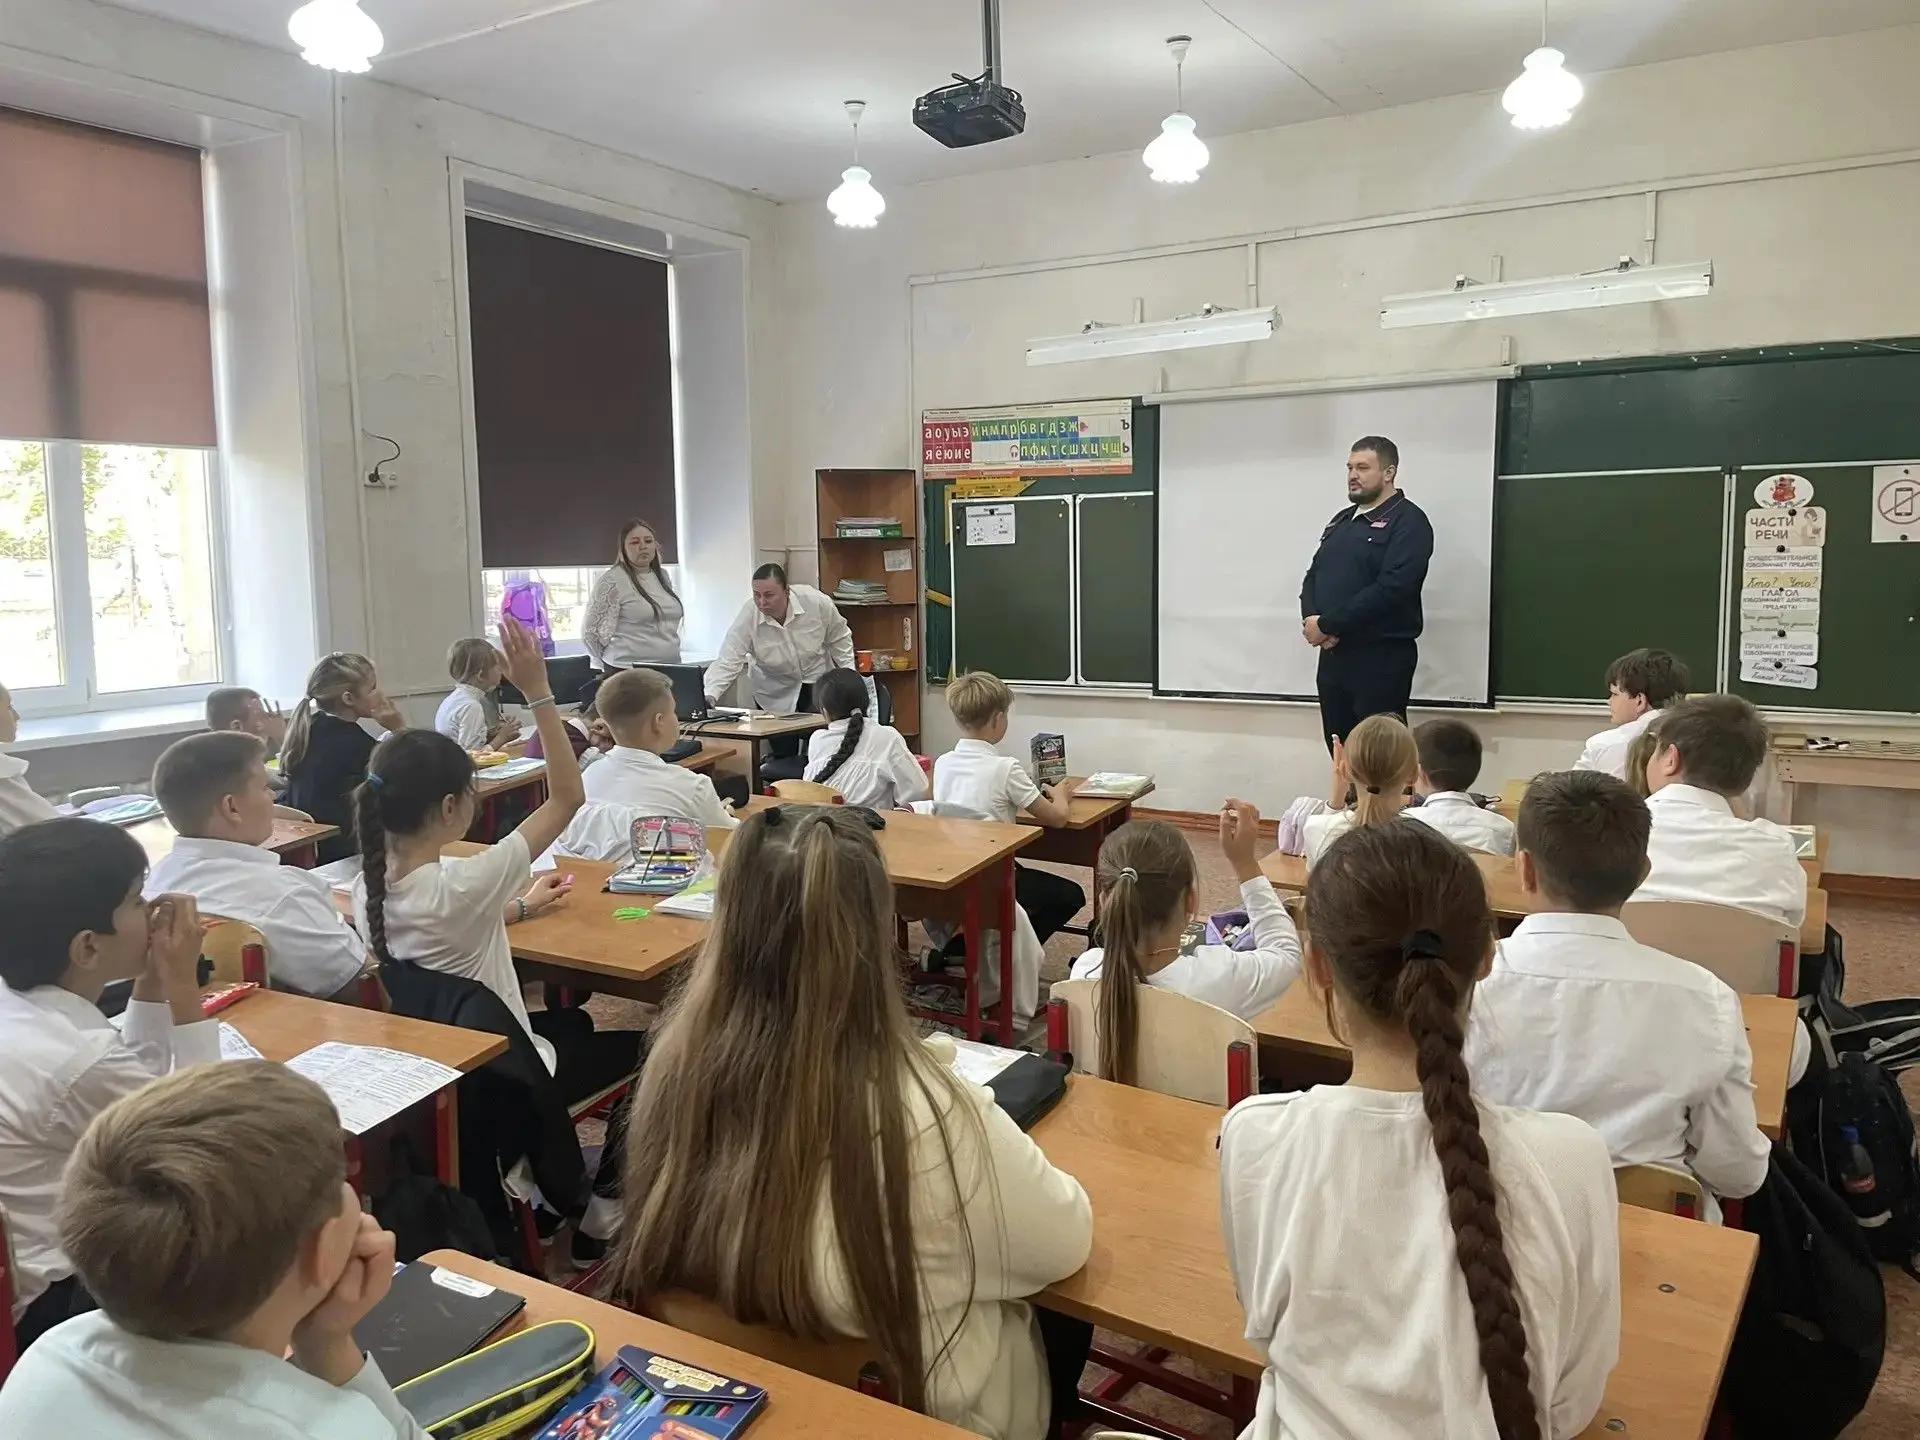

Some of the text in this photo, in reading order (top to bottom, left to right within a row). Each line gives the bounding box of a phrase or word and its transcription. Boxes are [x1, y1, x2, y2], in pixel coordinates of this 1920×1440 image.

[1750, 516, 1794, 527] ЧАСТИ
[1755, 529, 1789, 540] РЕЧИ
[1747, 576, 1819, 588] Кто? Что?
